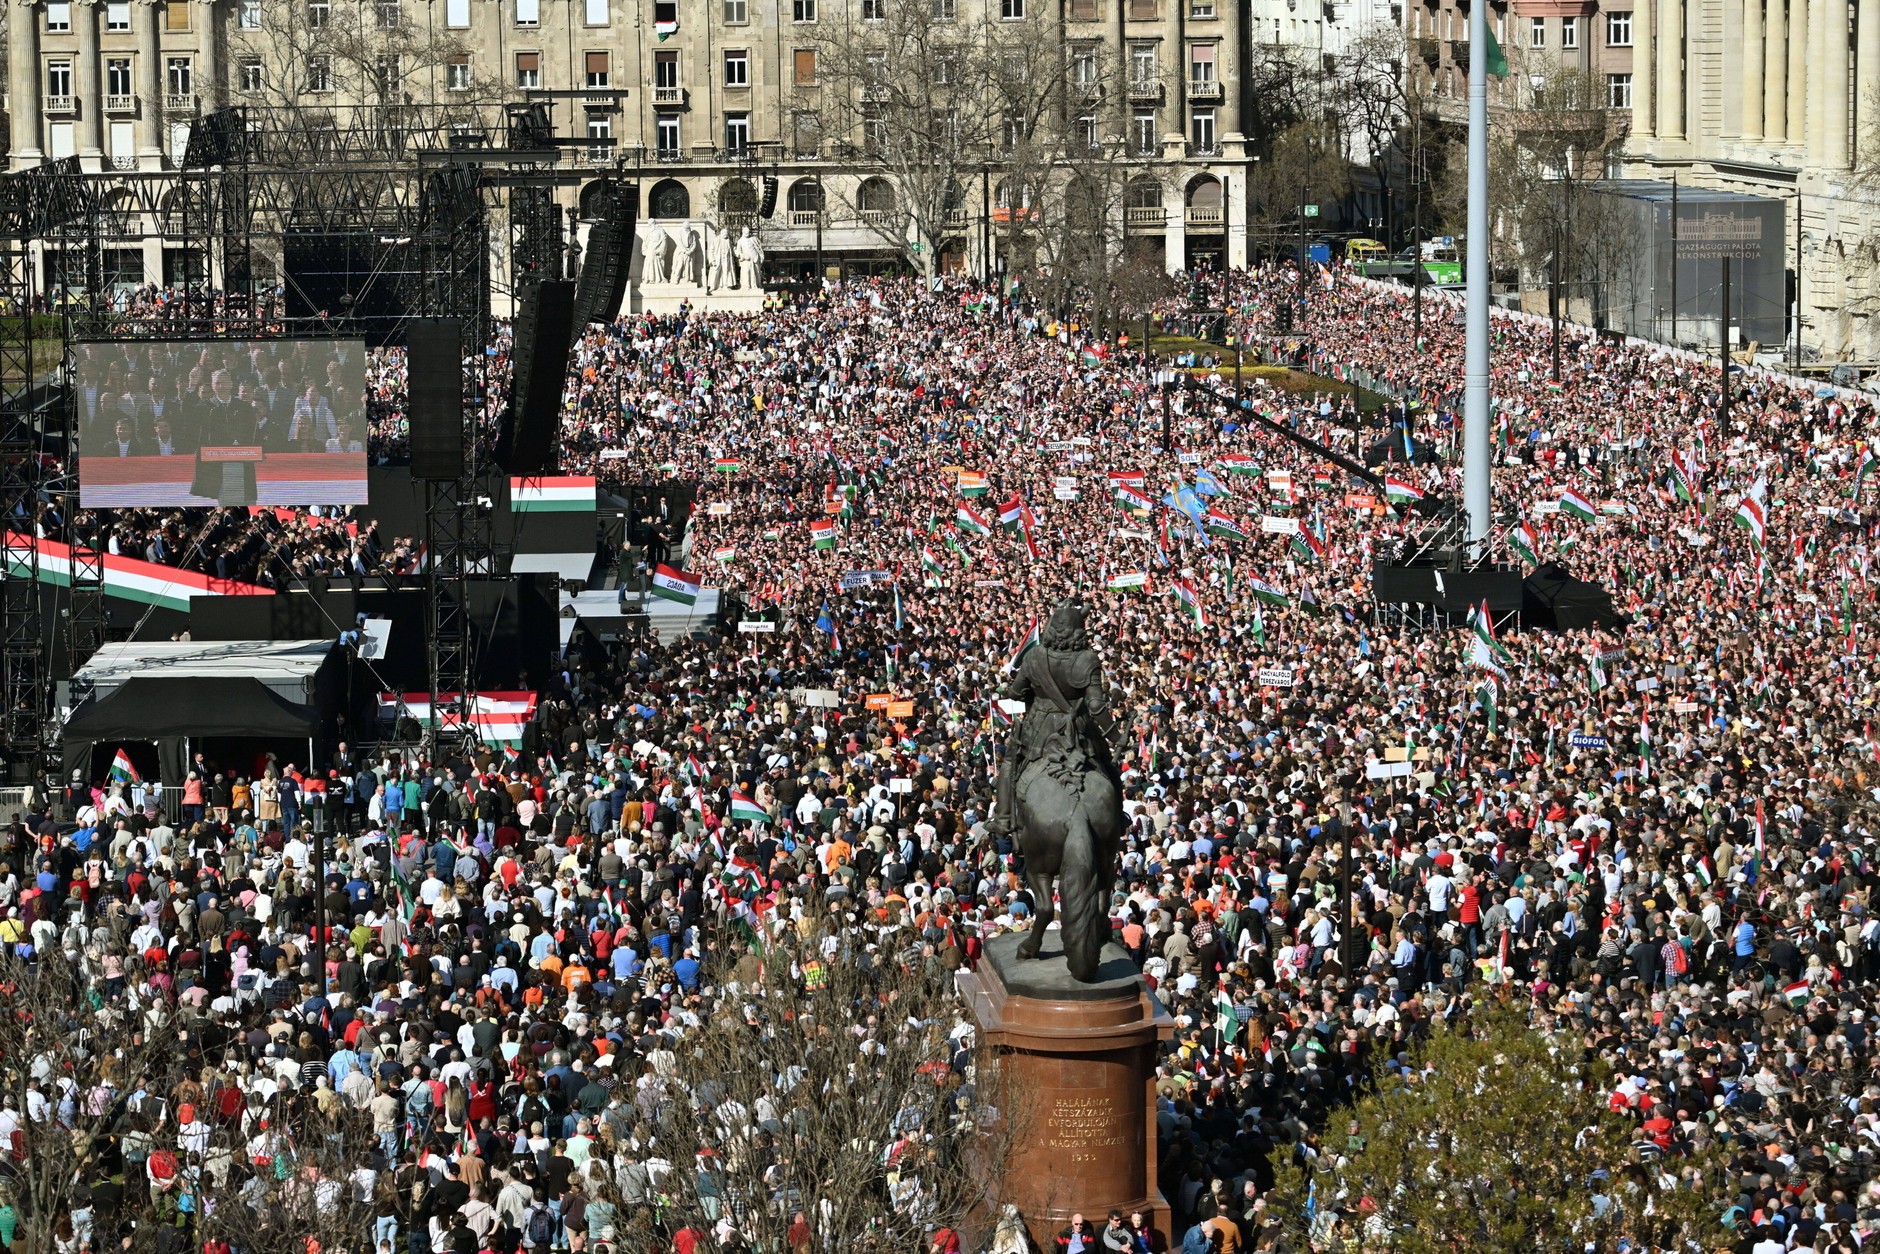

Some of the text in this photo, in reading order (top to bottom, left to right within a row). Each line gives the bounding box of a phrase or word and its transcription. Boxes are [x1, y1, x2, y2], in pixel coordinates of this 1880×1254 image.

[1676, 242, 1730, 250] IGAZSÁGÜGYI
[1574, 736, 1605, 745] SIÓFOK
[1056, 1098, 1110, 1107] HALÁLÁNAK
[1052, 1108, 1113, 1117] KÉTSZÁZADIK
[1048, 1117, 1116, 1127] ÉVFORDULÓJÁN
[1059, 1128, 1108, 1137] ÁLLÍTOTTA
[1091, 1136, 1125, 1147] NEMZET
